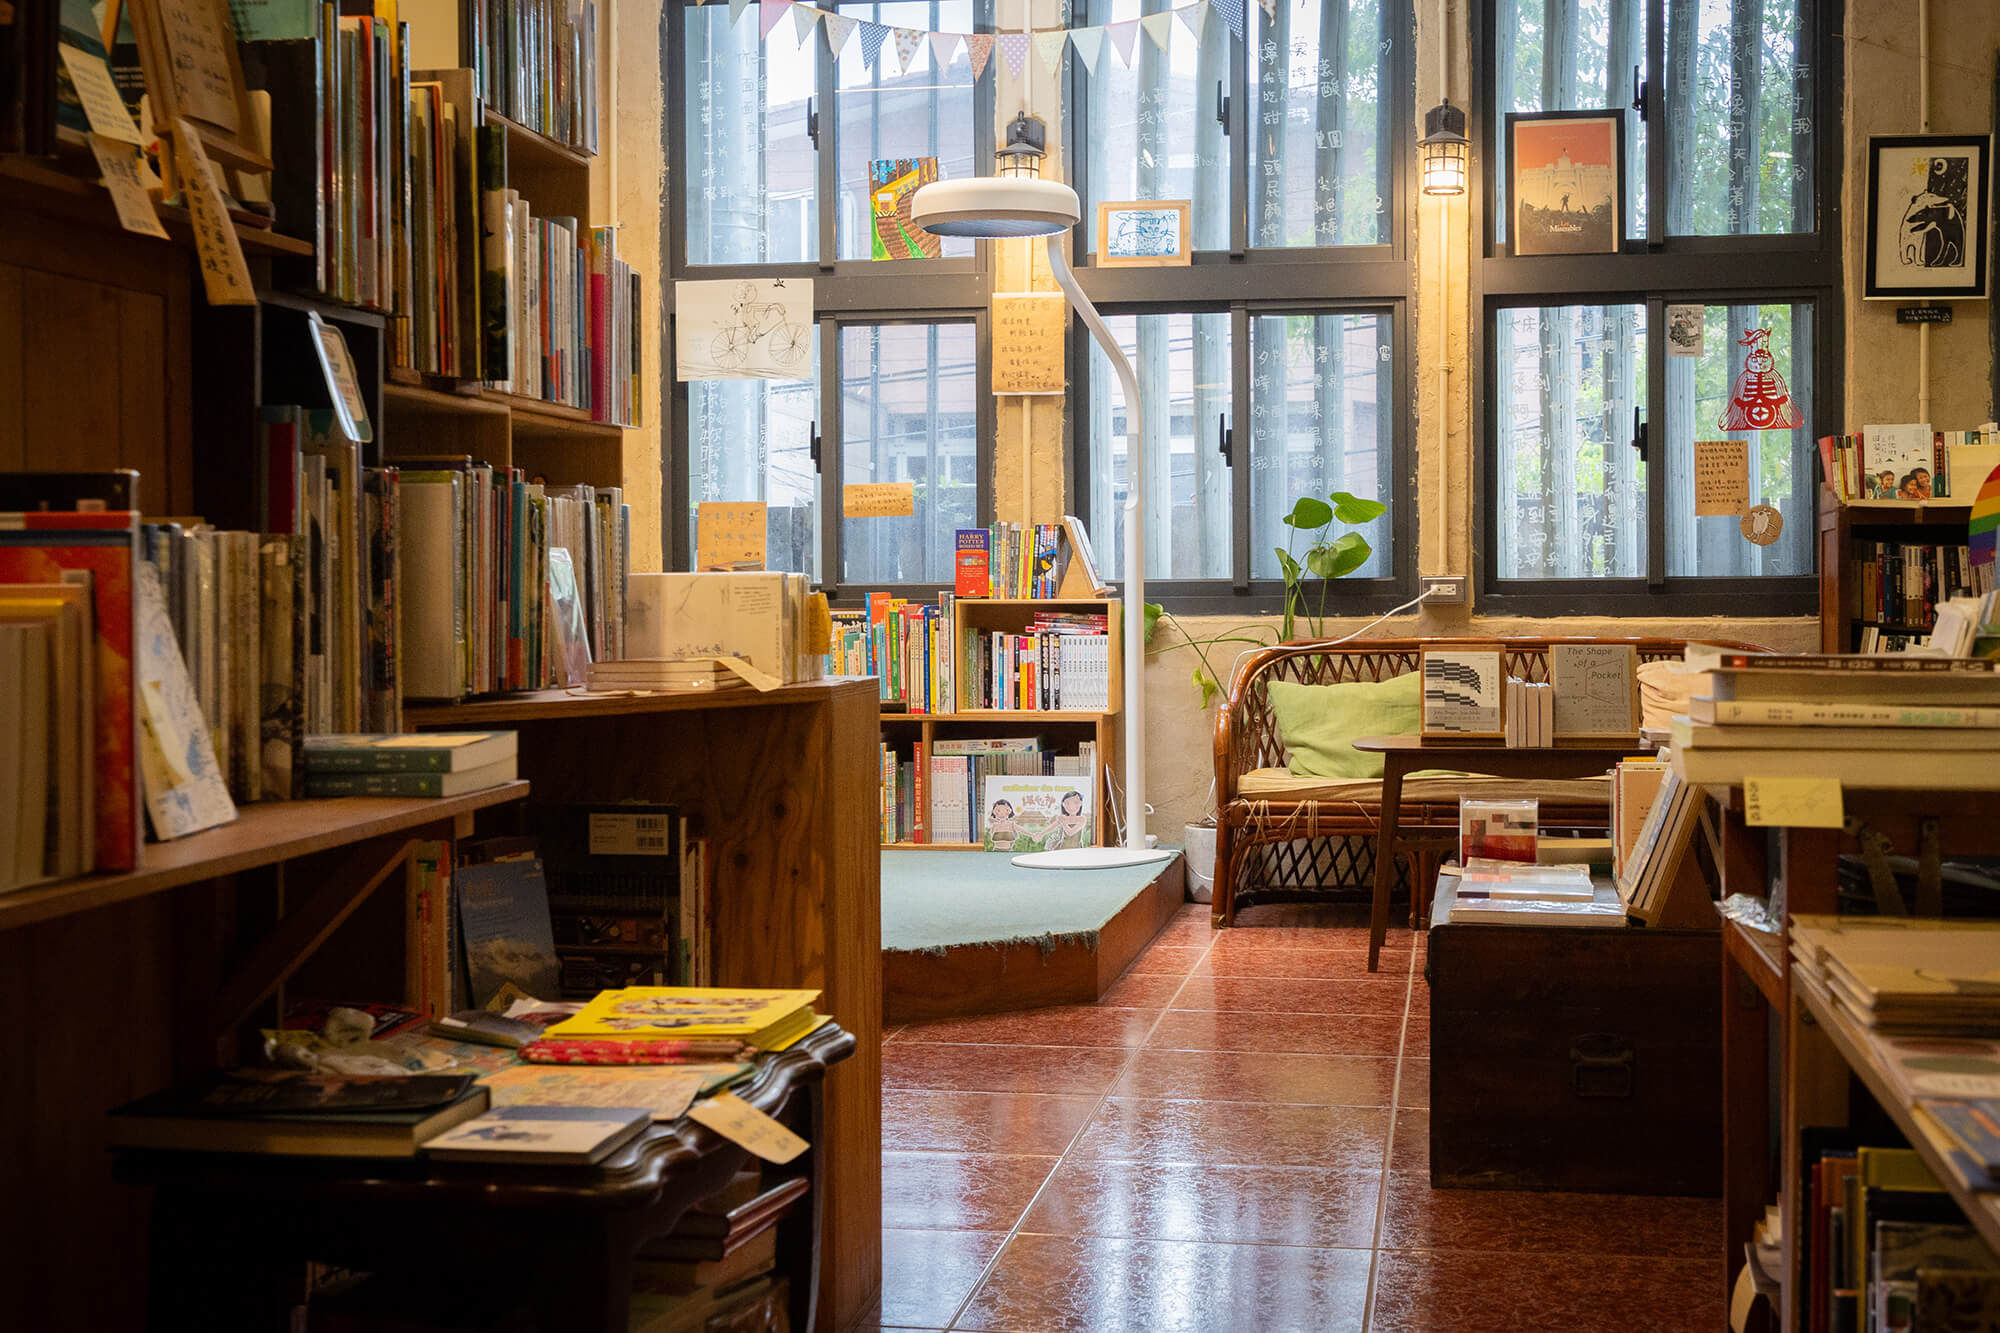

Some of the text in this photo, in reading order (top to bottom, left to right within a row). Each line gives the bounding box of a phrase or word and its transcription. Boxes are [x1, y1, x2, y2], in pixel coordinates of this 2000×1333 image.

[1567, 647, 1612, 655] The Shape
[1578, 659, 1588, 668] of
[1592, 671, 1621, 680] Pocket
